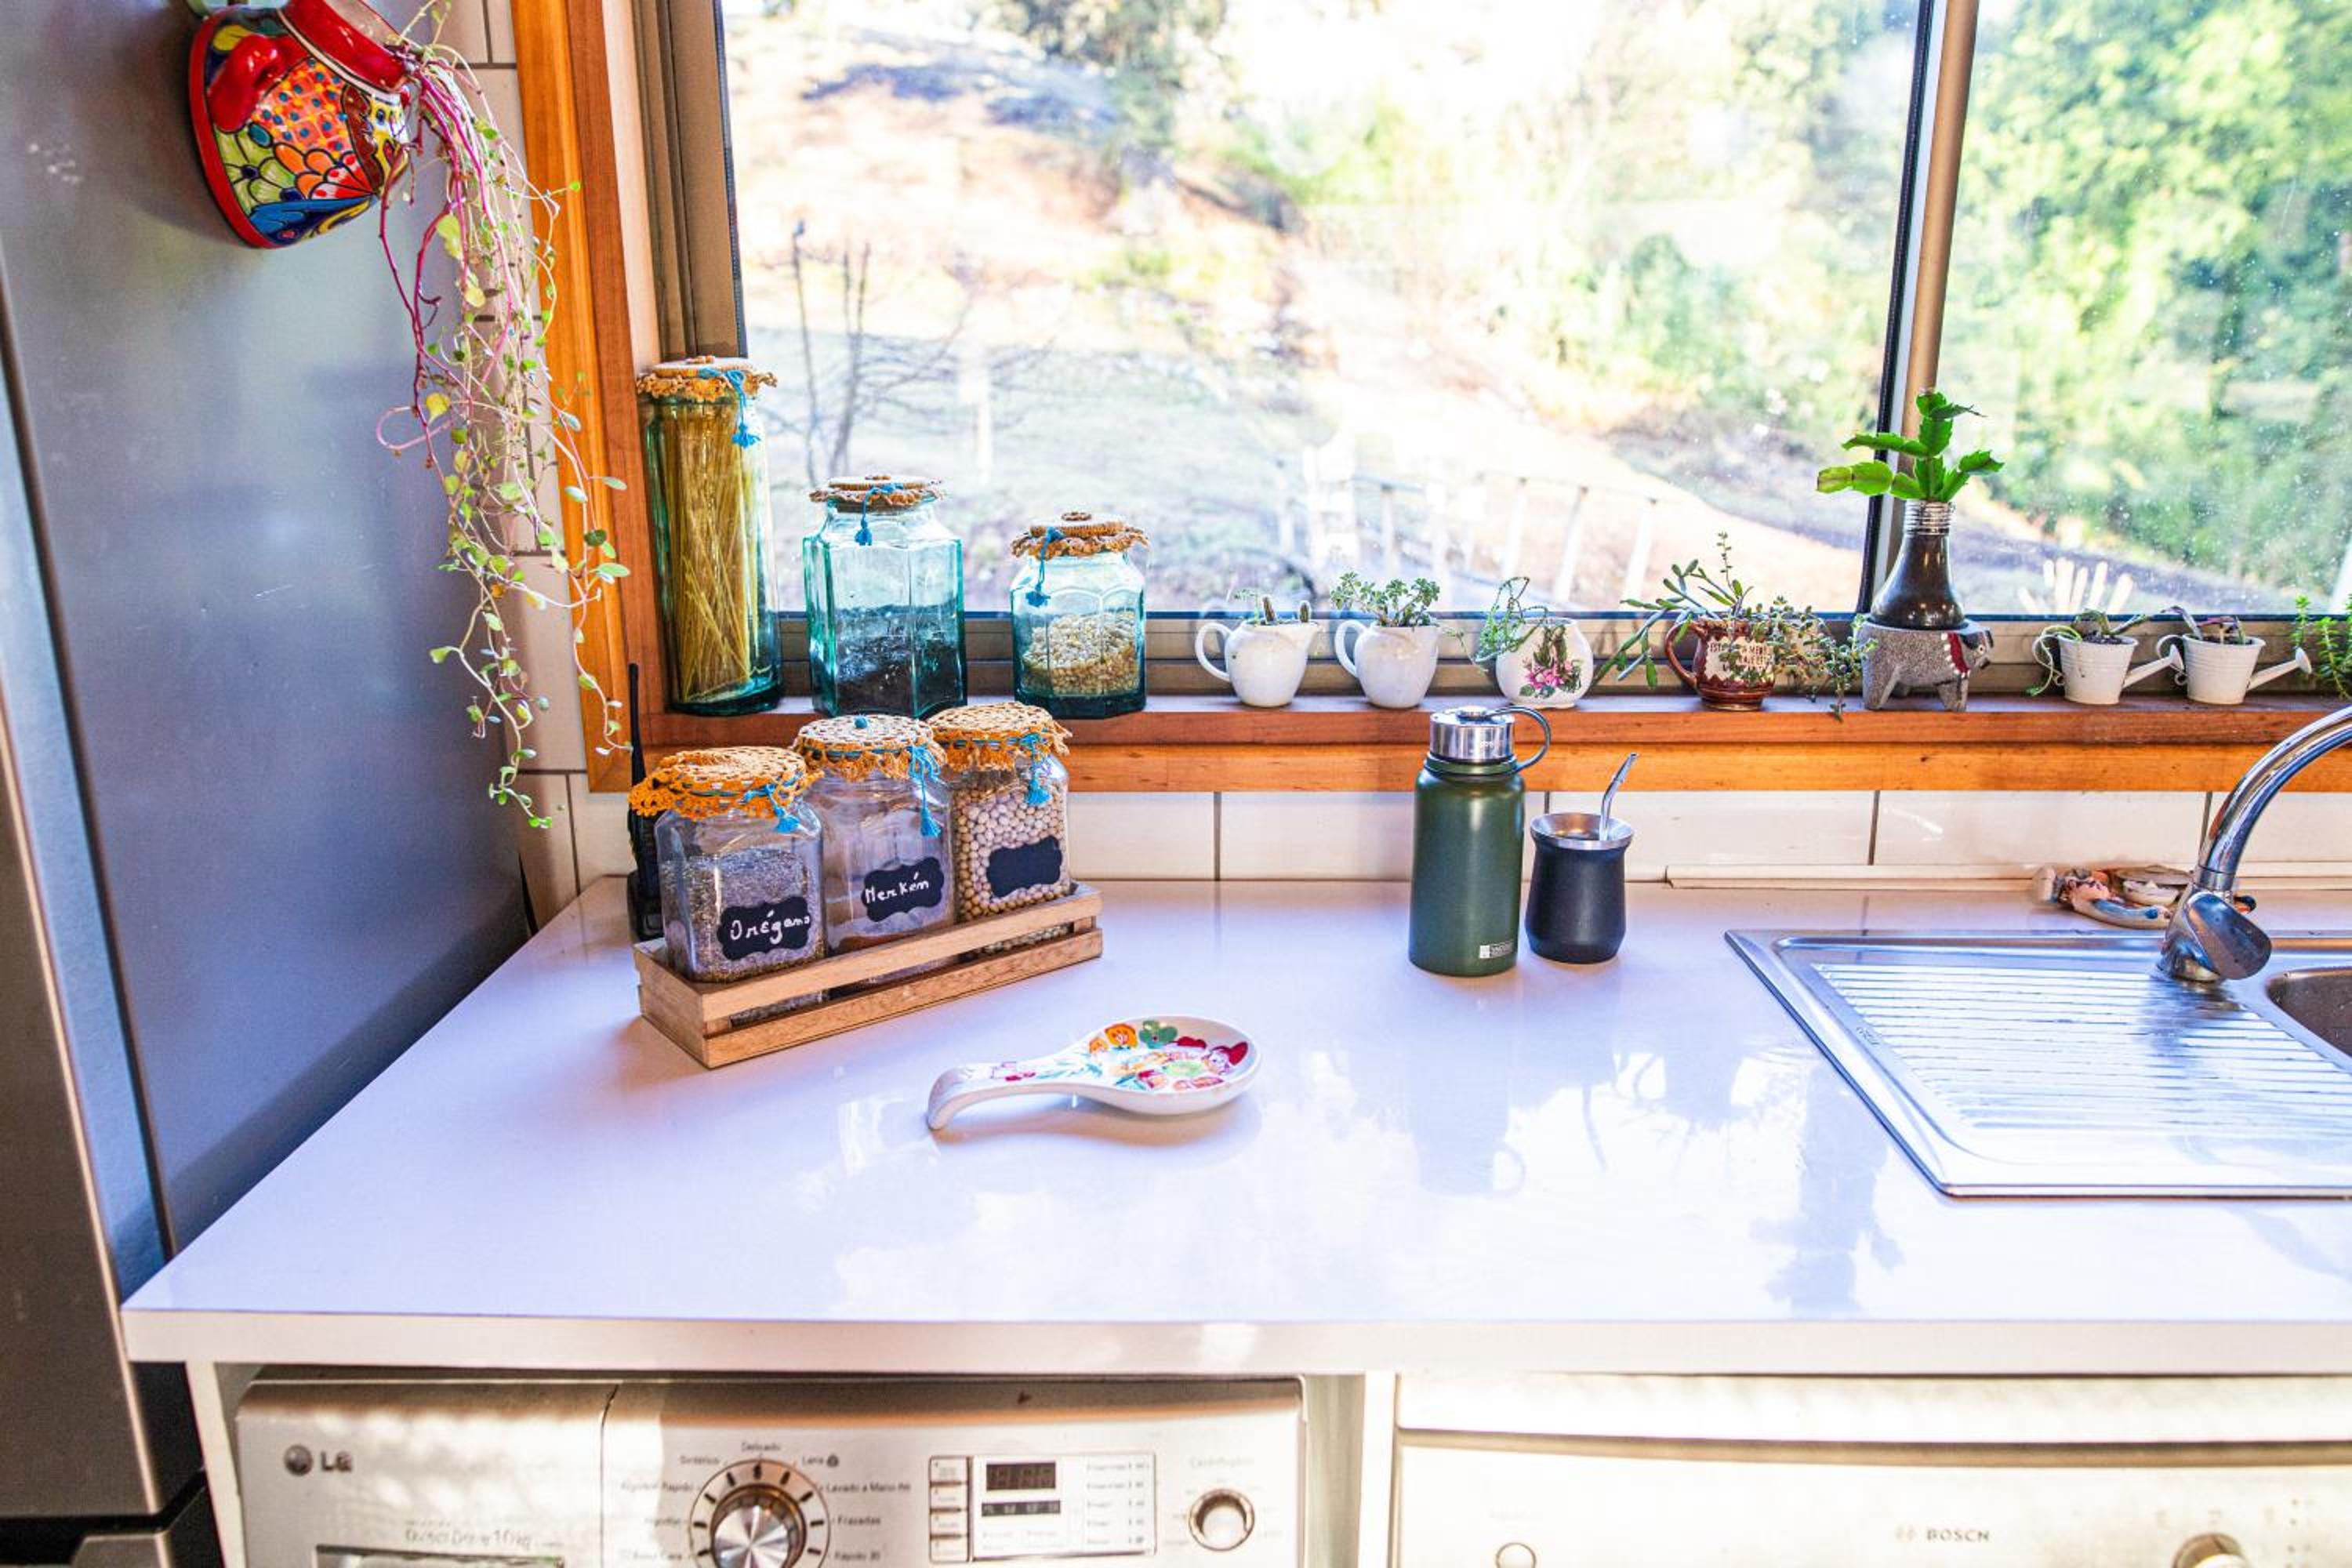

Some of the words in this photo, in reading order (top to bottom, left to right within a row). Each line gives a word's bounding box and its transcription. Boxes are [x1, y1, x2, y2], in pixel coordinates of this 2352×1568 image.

[729, 909, 811, 945] Orégano
[320, 1450, 353, 1472] LG
[1926, 1527, 1989, 1542] BOSCH
